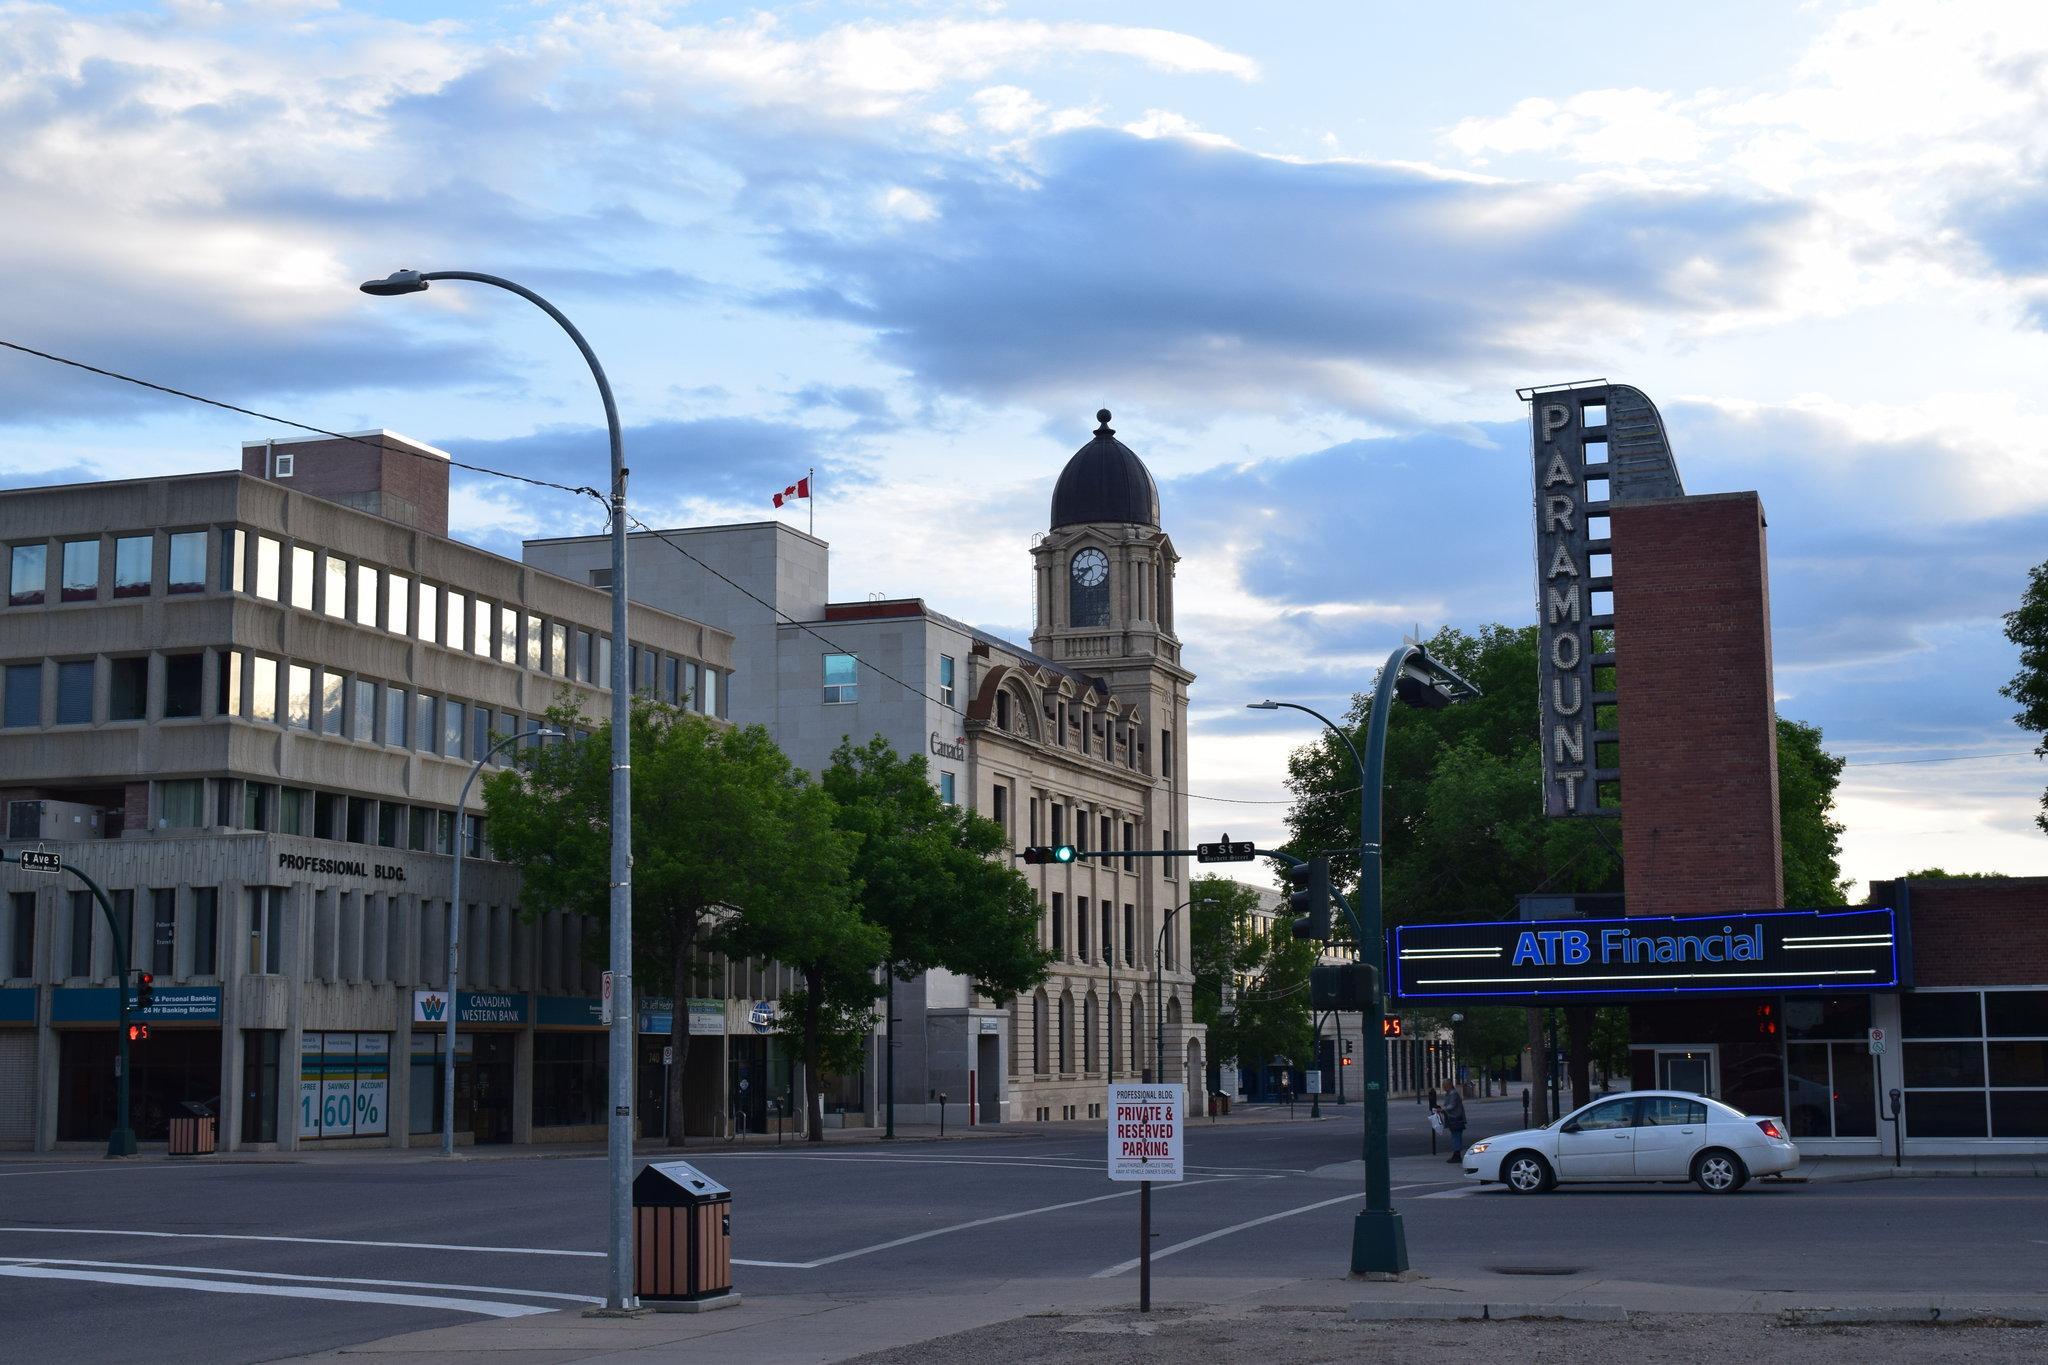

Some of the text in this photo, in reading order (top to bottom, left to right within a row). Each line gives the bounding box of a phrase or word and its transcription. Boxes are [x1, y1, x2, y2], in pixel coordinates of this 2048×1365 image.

[1542, 403, 1586, 811] PARAMOUNT
[930, 731, 964, 761] Canada
[1201, 843, 1251, 855] 8 St S
[23, 853, 59, 865] 4 Ave S
[280, 853, 407, 881] PROFESSIONAL BLDG.
[1511, 923, 1764, 967] ATB Financial
[190, 995, 217, 1003] Banking
[470, 995, 512, 1008] CANADIAN
[162, 1006, 188, 1014] Banking
[461, 1009, 519, 1021] WESTERN BANK
[328, 1082, 350, 1090] SAVINGS
[360, 1081, 384, 1089] ACCOUNT
[1116, 1090, 1175, 1099] PROFESSIONAL BLDG.
[1117, 1106, 1173, 1121] PRIVATE &
[1117, 1124, 1173, 1138] RESERVED
[1122, 1141, 1169, 1156] PARKING
